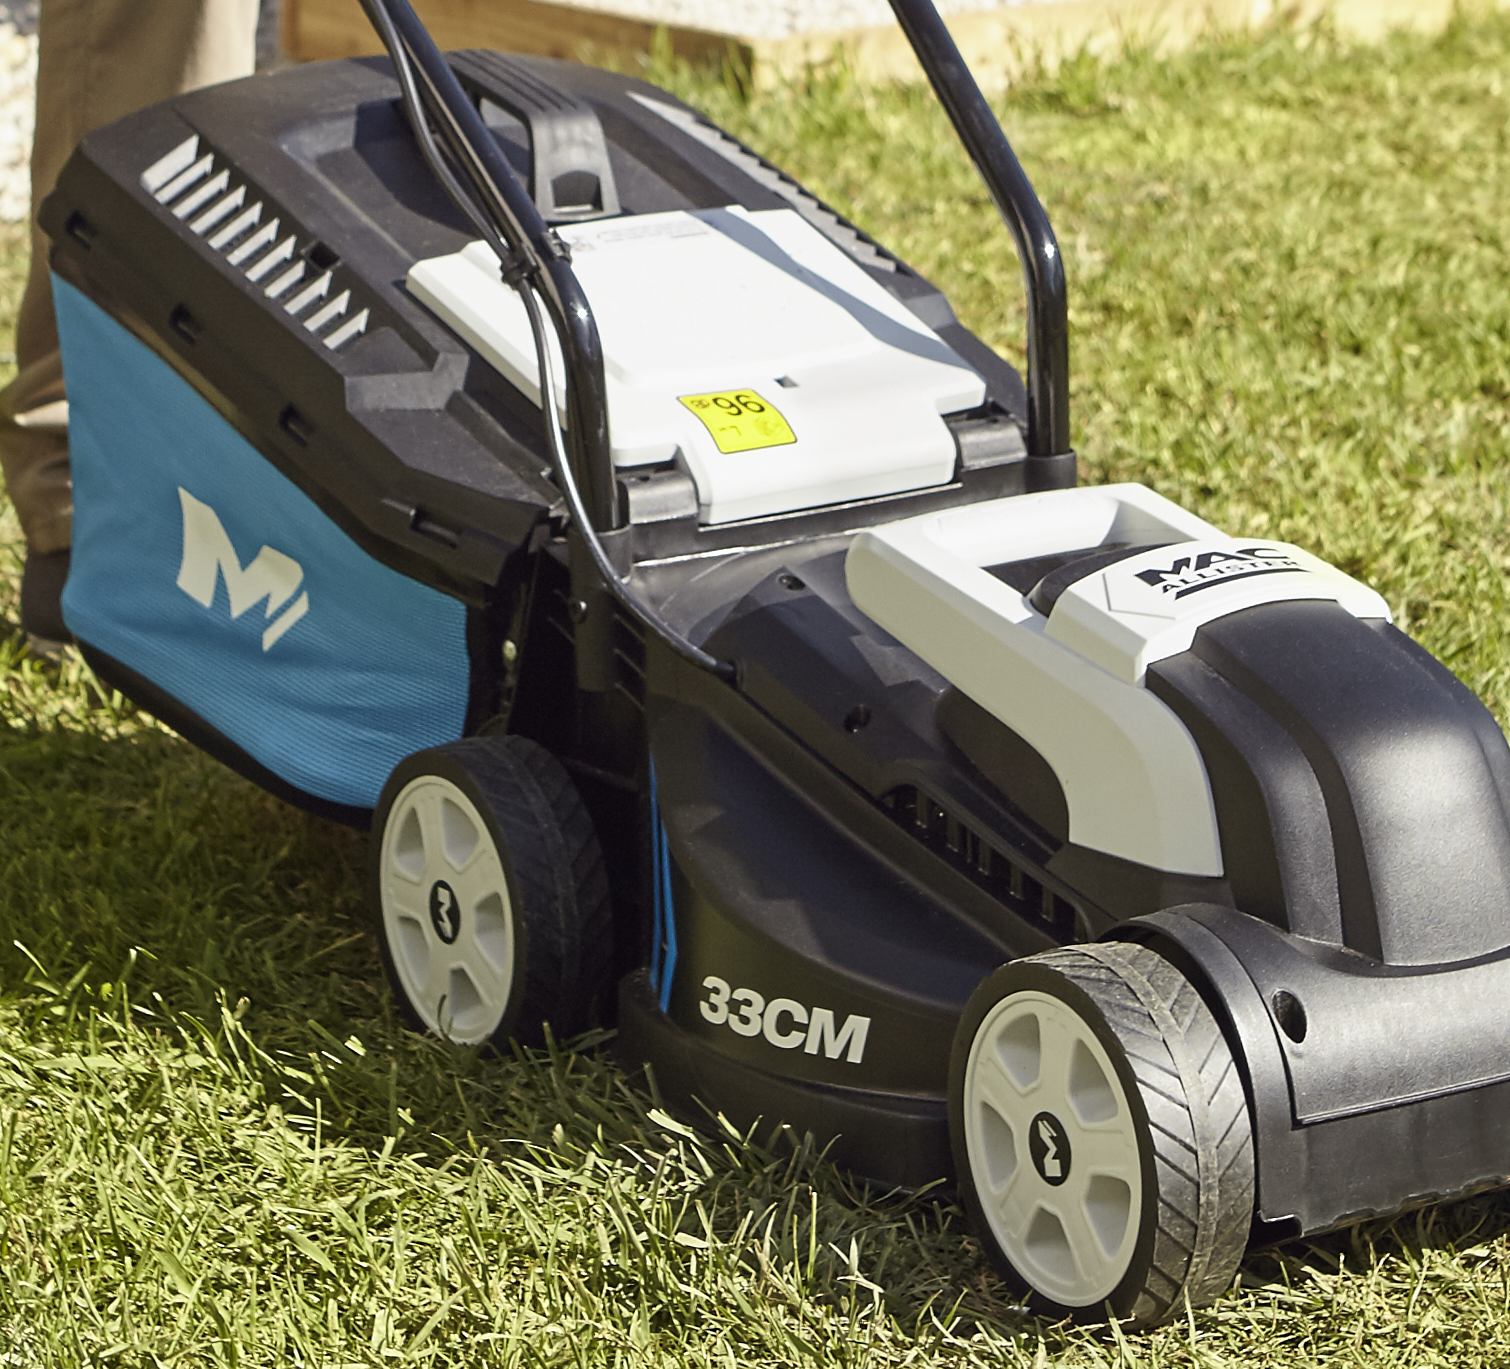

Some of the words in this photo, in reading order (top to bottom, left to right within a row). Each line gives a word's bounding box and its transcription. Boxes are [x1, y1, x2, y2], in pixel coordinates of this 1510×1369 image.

[711, 394, 766, 416] 96
[1134, 547, 1290, 587] MAC
[1162, 560, 1301, 593] ALLISTER
[699, 976, 871, 1064] 33CM
